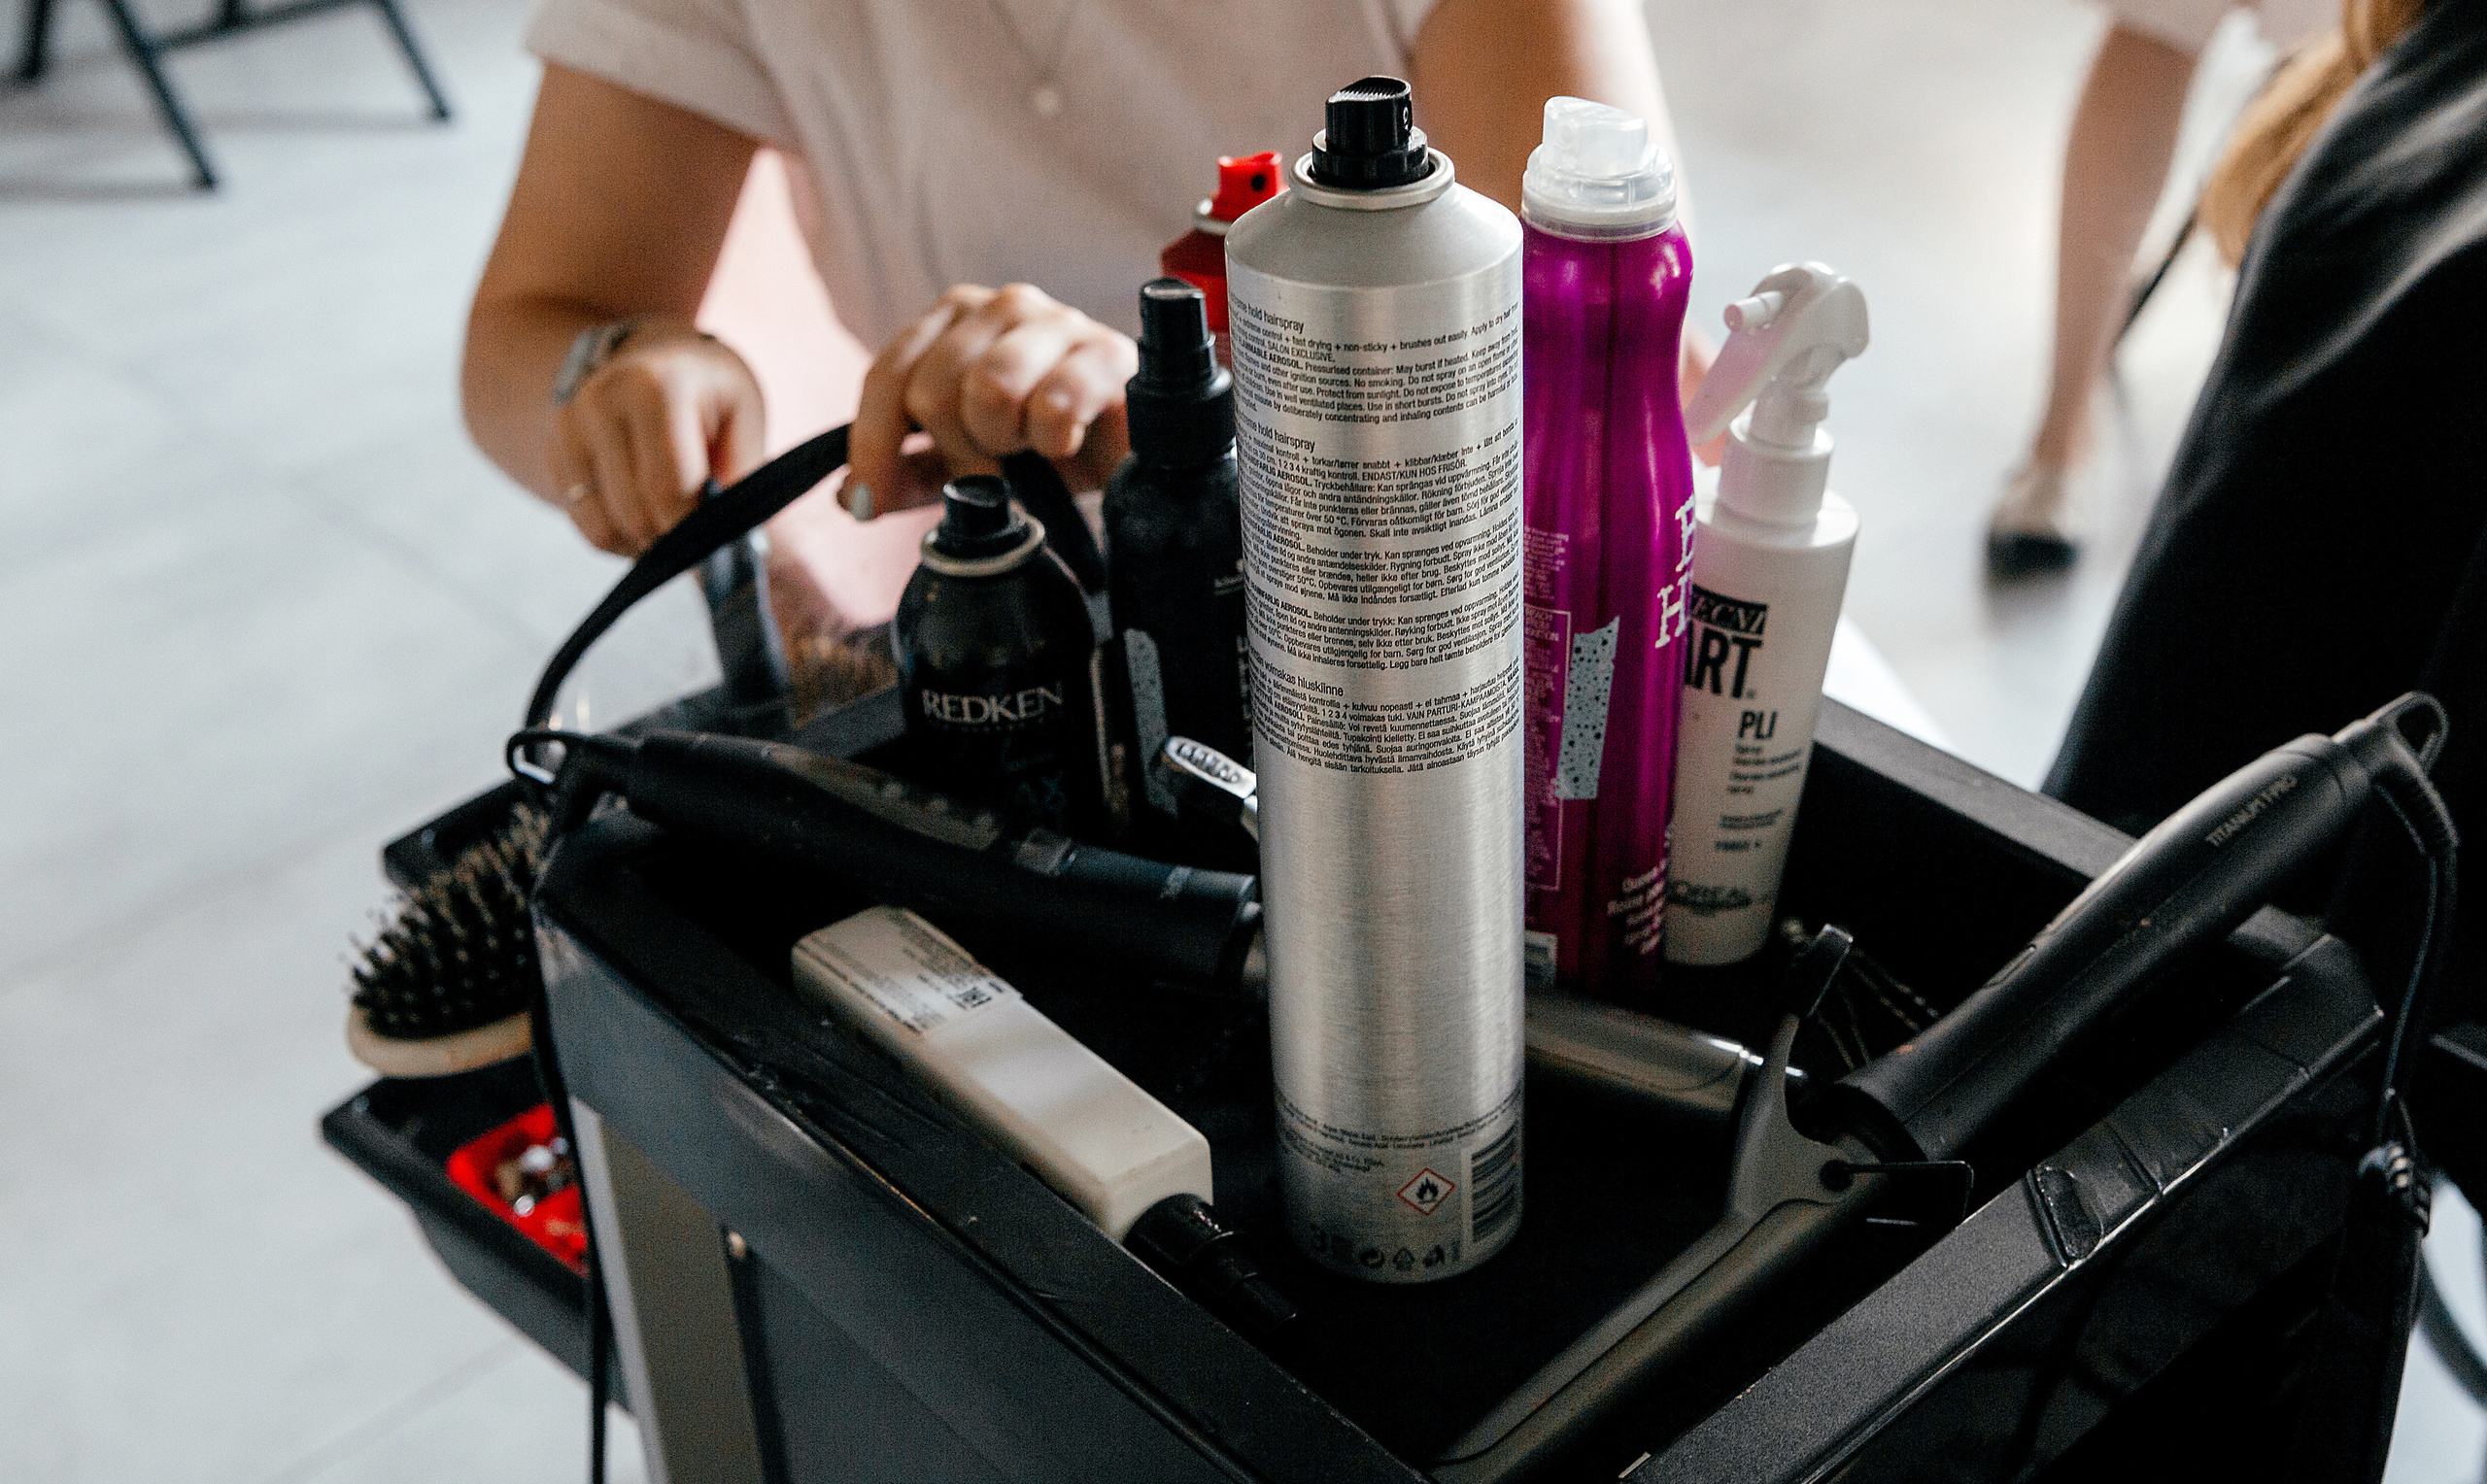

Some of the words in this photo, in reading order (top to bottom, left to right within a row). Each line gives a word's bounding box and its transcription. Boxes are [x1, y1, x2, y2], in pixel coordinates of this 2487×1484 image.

[1264, 311, 1304, 335] hairspray
[1268, 340, 1289, 354] SALON
[1291, 347, 1335, 361] EXCLUSIVE.
[1292, 335, 1305, 347] fast
[1308, 338, 1331, 353] drying
[1344, 342, 1387, 354] non-sticky
[1400, 338, 1431, 350] brushes
[1434, 334, 1446, 345] out
[1305, 361, 1349, 374] Pressurised
[1352, 366, 1393, 375] container:
[1396, 364, 1413, 375] May
[1415, 359, 1435, 371] burst
[1437, 358, 1442, 368] if
[1445, 352, 1469, 366] heated.
[1472, 347, 1485, 358] Keep
[1290, 370, 1315, 384] ignition
[1318, 377, 1351, 387] sources.
[1354, 378, 1365, 387] No
[1368, 377, 1405, 388] smoking.
[1408, 375, 1418, 385] Do
[1421, 372, 1433, 383] not
[1436, 369, 1455, 382] spray
[1458, 365, 1466, 375] on
[1282, 381, 1298, 391] after
[1300, 386, 1313, 394] use.
[1316, 387, 1344, 398] Protect
[1346, 389, 1364, 398] from
[1367, 388, 1401, 400] sunlight.
[1403, 388, 1414, 396] Do
[1415, 385, 1428, 395] not
[1430, 381, 1455, 394] expose
[1457, 378, 1463, 387] to
[1284, 392, 1297, 402] well
[1299, 397, 1335, 409] ventilated
[1337, 401, 1364, 412] places.
[1367, 401, 1382, 410] Use
[1385, 401, 1392, 410] in
[1395, 399, 1414, 409] short
[1417, 395, 1443, 407] bursts.
[1446, 391, 1455, 401] Do
[1457, 387, 1467, 398] not
[1282, 402, 1322, 422] deliberately
[1324, 413, 1380, 424] concentrating
[1382, 412, 1397, 422] and
[1400, 409, 1430, 421] inhaling
[1433, 401, 1463, 416] contents
[1466, 397, 1477, 408] can
[1275, 429, 1314, 454] hairspray
[1278, 458, 1281, 467] 1
[1283, 459, 1287, 469] 2
[1290, 461, 1293, 471] 3
[1296, 463, 1299, 472] 4
[1302, 464, 1325, 480] kraftig
[1327, 469, 1359, 480] kontroll.
[1362, 468, 1416, 480] ENDAST/KUN
[1419, 465, 1436, 477] HOS
[1362, 459, 1389, 468] snabbt
[1277, 468, 1312, 487] AEROSOL.
[1378, 483, 1393, 491] Kan
[1435, 475, 1446, 486] vid
[1303, 489, 1316, 498] och
[1318, 491, 1341, 501] andra
[1303, 498, 1316, 509] inte
[1318, 503, 1358, 514] punkteras
[1291, 520, 1313, 533] spraya
[1316, 525, 1331, 534] mot
[1370, 528, 1389, 537] Skall
[1393, 527, 1408, 536] inte
[1412, 520, 1446, 534] avsiktligt
[1323, 514, 1334, 523] 50
[1350, 517, 1387, 525] Förvaras
[1296, 554, 1315, 564] andre
[1390, 560, 1421, 572] Rygning
[1423, 554, 1450, 566] forbudt.
[1453, 548, 1471, 561] Spray
[1306, 544, 1337, 556] Beholder
[1364, 552, 1381, 561] tryk.
[1441, 541, 1453, 552] ved
[1302, 565, 1315, 576] eller
[1401, 571, 1417, 580] efter
[1421, 568, 1440, 578] brug.
[1444, 557, 1476, 573] Beskyttes
[1318, 580, 1357, 591] Opbevares
[1327, 591, 1339, 601] Må
[1342, 593, 1357, 602] ikke
[1298, 620, 1306, 630] og
[1308, 622, 1326, 631] andre
[1427, 619, 1453, 631] forbudt.
[1313, 611, 1345, 624] Beholder
[1347, 617, 1369, 625] under
[1372, 617, 1394, 627] trykk:
[1398, 616, 1413, 624] Kan
[1414, 610, 1448, 624] sprenges
[1450, 604, 1462, 615] ved
[1692, 594, 1767, 635] ECNI
[1308, 631, 1321, 642] eller
[1324, 634, 1355, 648] brennes,
[1395, 637, 1412, 646] etter
[1414, 634, 1434, 644] bruk.
[1437, 624, 1469, 640] Beskyttes
[1438, 640, 1451, 654] god
[1298, 649, 1311, 660] ikke
[1312, 653, 1345, 666] inhaleres
[1346, 658, 1387, 671] forsettelig.
[1389, 659, 1409, 670] Legg
[1411, 658, 1427, 666] bare
[1429, 653, 1443, 663] helt
[1297, 675, 1343, 695] hiuskiinne
[921, 679, 1064, 725] REDKEN
[1351, 702, 1377, 711] kuivuu
[1380, 701, 1413, 713] nopeasti
[1425, 698, 1431, 707] ei
[1434, 692, 1459, 705] tahmaa
[1335, 710, 1340, 719] 3
[1407, 710, 1424, 720] VAIN
[1348, 722, 1359, 730] Voi
[1390, 715, 1456, 731] kuumennettaessa.
[1738, 711, 1777, 739] PLI
[1322, 739, 1339, 749] edes
[1376, 744, 1402, 755] Suojaa
[1465, 728, 1471, 738] Ei
[1345, 732, 1381, 744] Tupakointi
[1383, 732, 1415, 743] kielletty.
[1418, 730, 1424, 739] Ei
[1427, 729, 1440, 738] saa
[1442, 718, 1475, 735] suihkuttaa
[1427, 754, 1464, 769] ainoastaan
